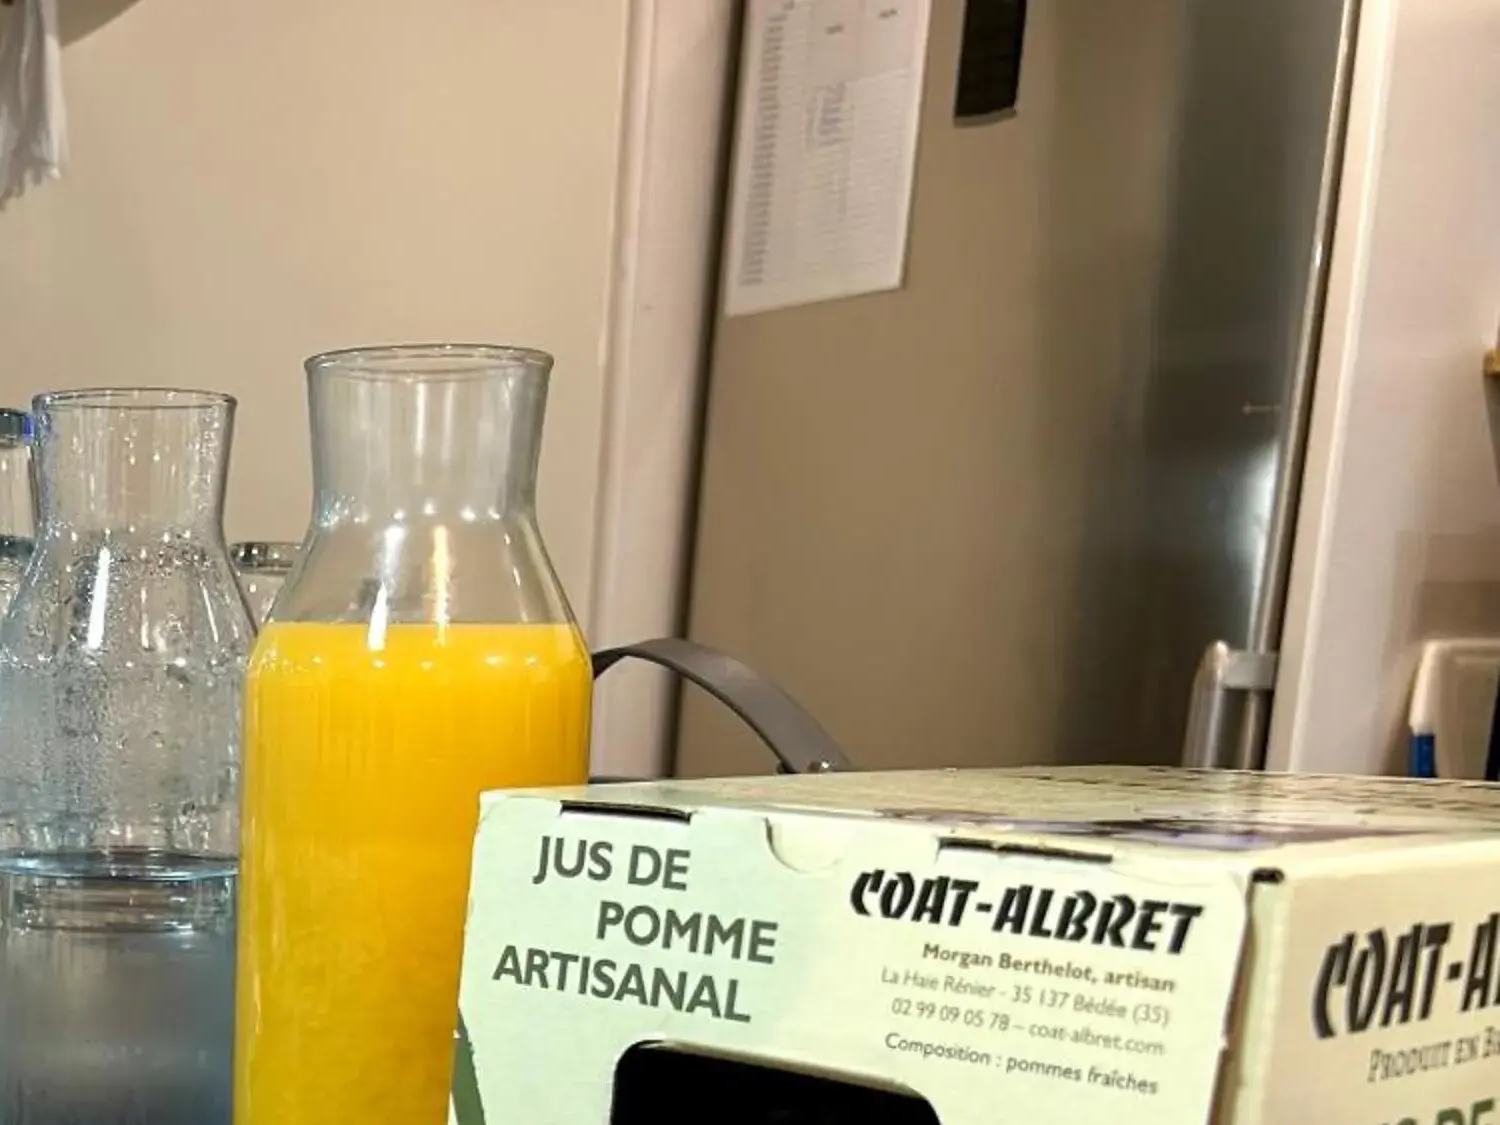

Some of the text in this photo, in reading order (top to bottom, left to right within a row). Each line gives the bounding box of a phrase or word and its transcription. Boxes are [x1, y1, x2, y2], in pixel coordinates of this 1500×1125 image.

[532, 835, 691, 891] JUS DE
[595, 899, 778, 964] POMME
[849, 868, 1204, 956] COAT-ALBRET
[491, 944, 751, 1023] ARTISANAL
[881, 966, 899, 985] La
[903, 969, 940, 991] Haie
[1012, 984, 1034, 1004] 35
[1039, 989, 1071, 1009] 137
[1132, 1003, 1171, 1029] (35)
[922, 942, 1177, 993] Morgan Berthelot, artisan
[1312, 911, 1500, 1040] COAT-A
[891, 997, 912, 1016] 02
[916, 1000, 937, 1020] 99
[939, 1004, 960, 1024] 09
[963, 1008, 985, 1028] 05
[989, 1011, 1011, 1031] 78
[884, 1032, 991, 1066] Composition
[1005, 1056, 1082, 1083] pommes
[1087, 1065, 1160, 1095] fraîches
